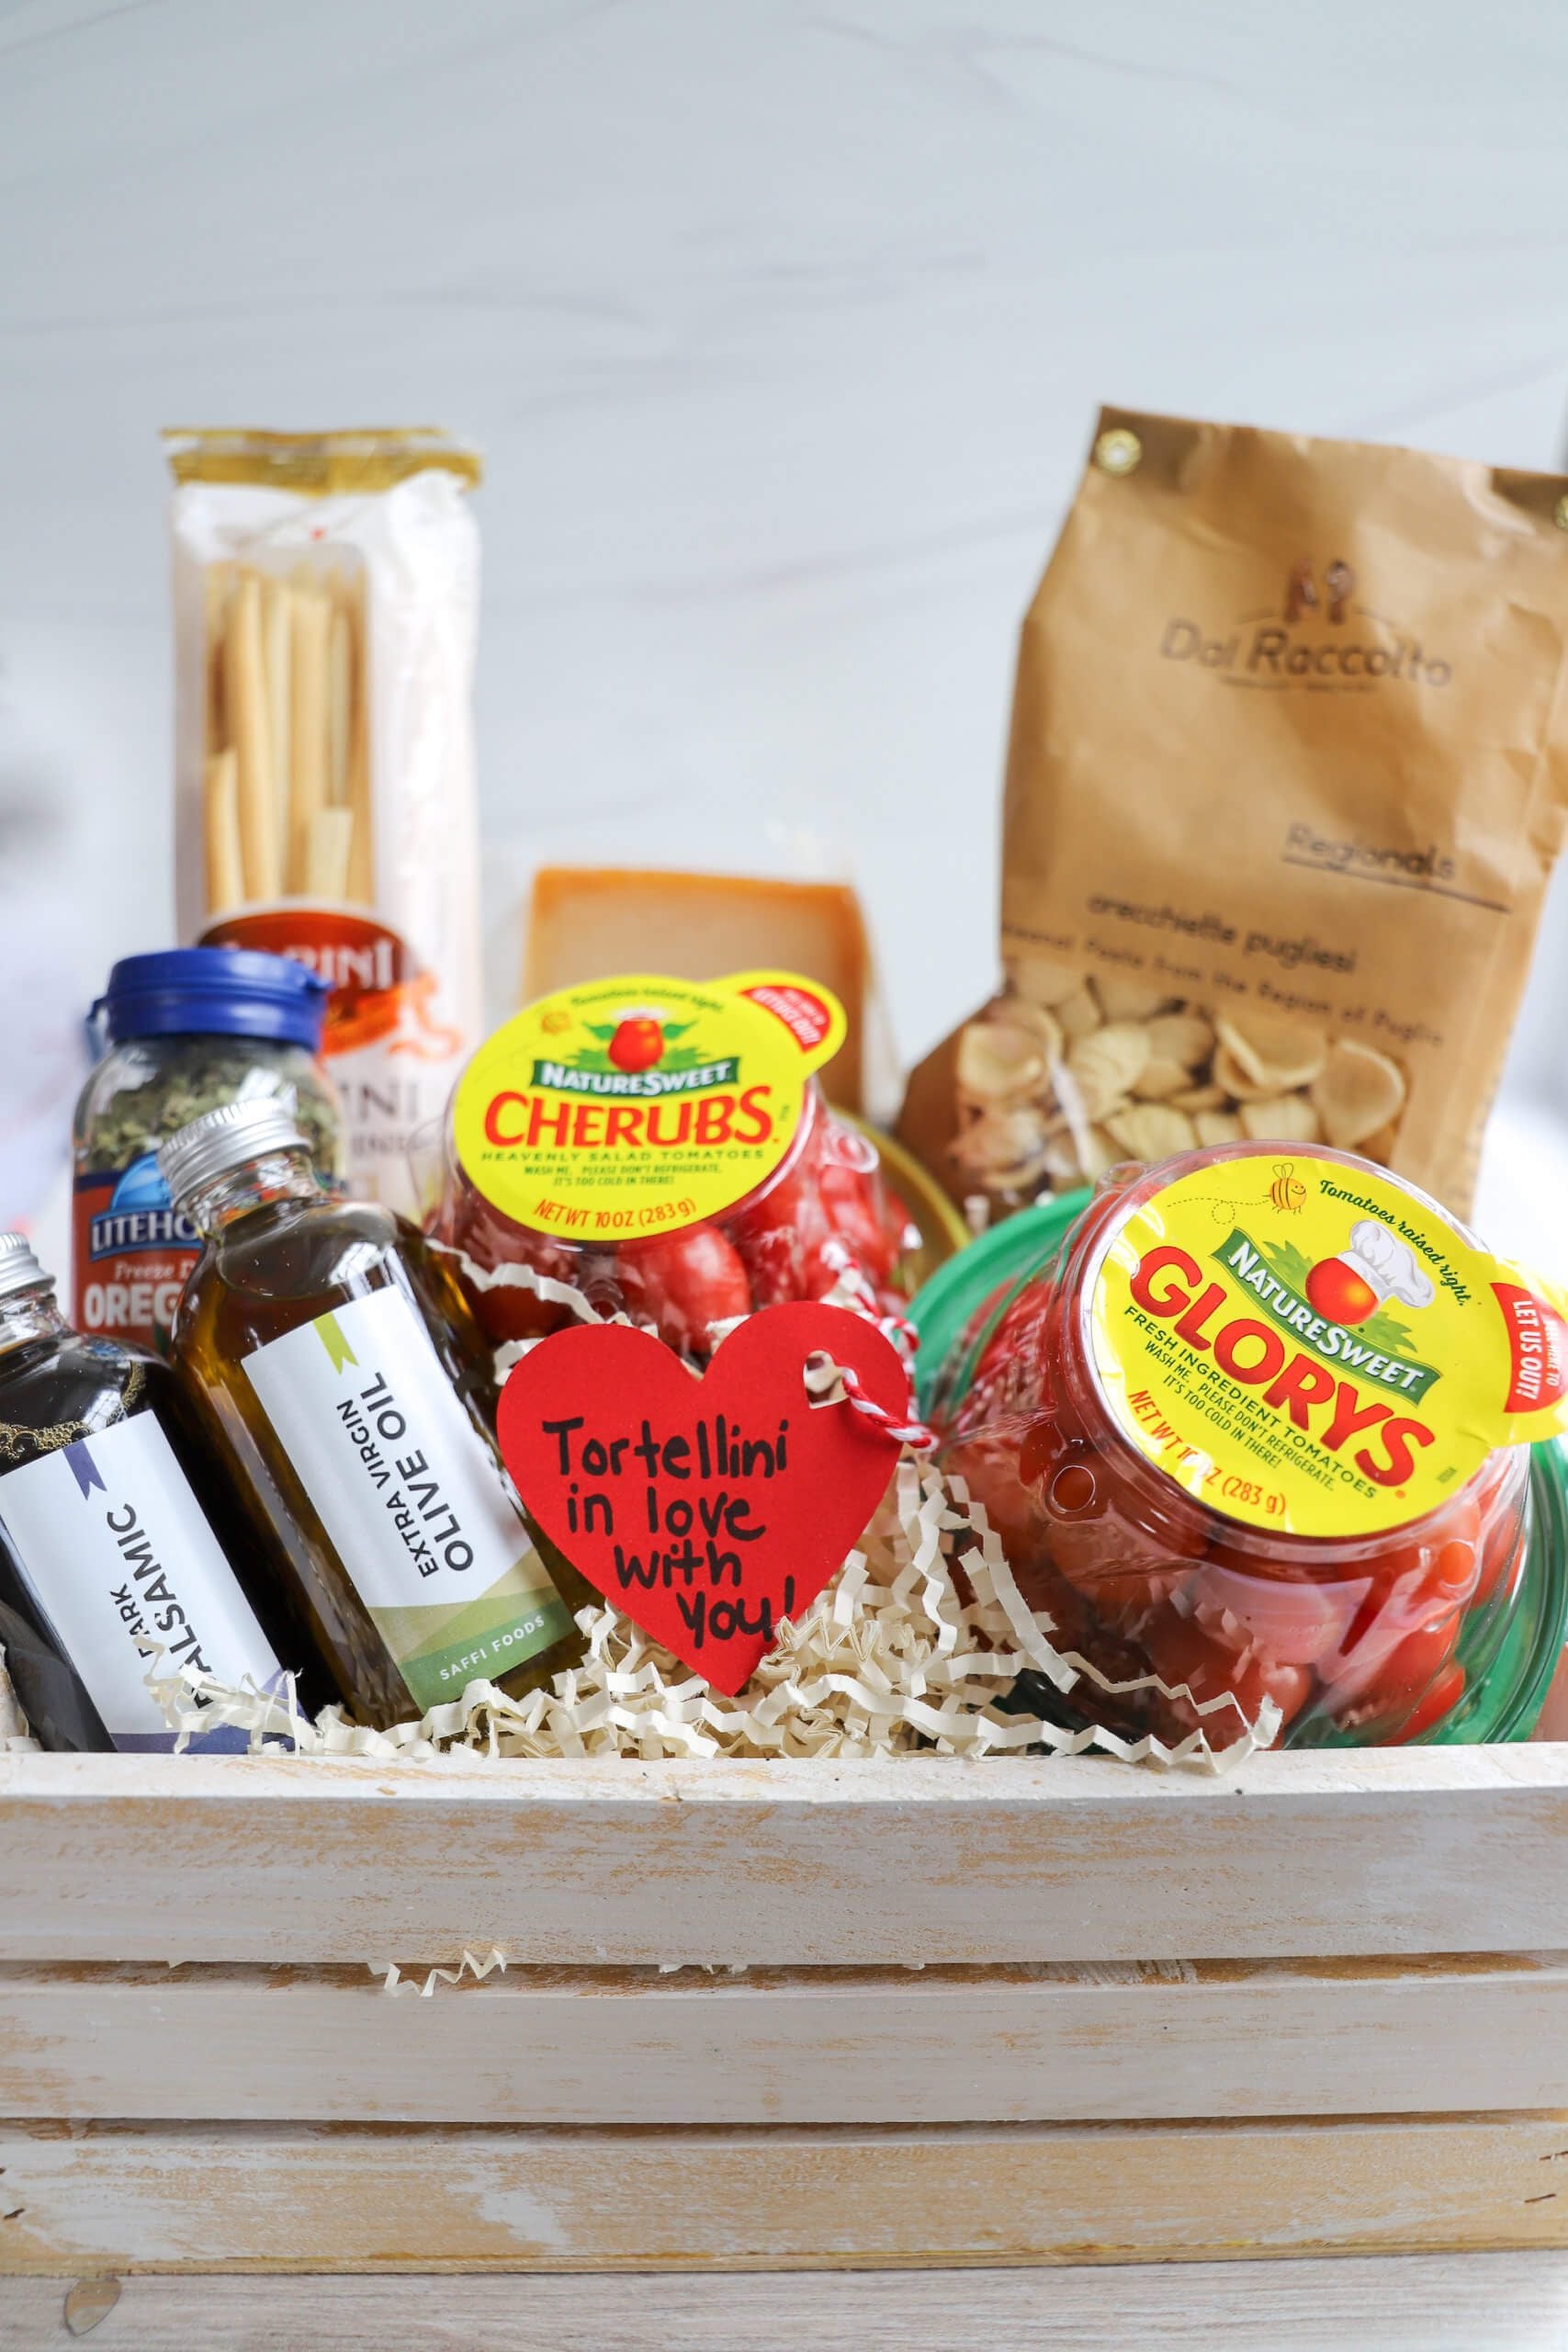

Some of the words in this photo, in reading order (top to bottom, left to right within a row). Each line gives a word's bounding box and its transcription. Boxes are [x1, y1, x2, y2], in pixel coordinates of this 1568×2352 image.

[1160, 617, 1240, 669] Dal
[1246, 626, 1453, 687] Raccolto
[1286, 821, 1457, 882] Regionals
[1243, 929, 1358, 975] pugliesi
[539, 1058, 732, 1097] NATURESWEET
[482, 1084, 773, 1148] CHERUBS
[480, 1151, 581, 1161] HEAVENLY
[588, 1150, 652, 1161] SALAD
[660, 1149, 764, 1159] TOMATOES
[533, 1198, 567, 1223] NET
[565, 1209, 591, 1227] WT
[595, 1211, 612, 1228] 10
[612, 1210, 635, 1228] OZ
[638, 1202, 677, 1228] (283
[677, 1197, 697, 1217] g)
[1320, 1179, 1396, 1225] Tomatoes
[1398, 1220, 1446, 1265] raised
[1438, 1263, 1472, 1306] right.
[114, 1260, 175, 1281] Freeze
[1228, 1240, 1425, 1392] NATURESWEET
[1512, 1299, 1540, 1328] LET
[1518, 1331, 1543, 1353] US
[1130, 1245, 1437, 1487] GLORYS
[1514, 1358, 1543, 1401] OUT!
[1545, 1371, 1561, 1388] TO
[359, 1371, 407, 1442] OIL
[1124, 1306, 1178, 1352] FRESH
[1178, 1348, 1281, 1428] INGREDIENT
[1282, 1426, 1378, 1499] TOMATOES
[1144, 1340, 1177, 1372] WASH
[1173, 1363, 1191, 1384] ME.
[1198, 1382, 1235, 1416] PLEASE
[1234, 1408, 1269, 1439] DON'T
[1265, 1434, 1335, 1492] REFRIGERATE.
[1163, 1374, 1185, 1396] IT'S
[1182, 1389, 1206, 1412] TOO
[1204, 1406, 1232, 1431] COLD
[1229, 1421, 1247, 1442] IN
[1245, 1435, 1283, 1470] THERE!
[336, 1398, 392, 1489] VIRGIN
[541, 1414, 790, 1480] Tortellini
[1128, 1389, 1162, 1423] NET
[1221, 1476, 1264, 1506] (283
[1265, 1492, 1287, 1517] g)
[386, 1489, 441, 1578] EXTRA
[394, 1449, 475, 1572] OLIVE
[567, 1483, 615, 1536] in
[647, 1486, 766, 1543] love
[439, 1647, 488, 1680] SAFFI
[491, 1614, 546, 1653] FOODS
